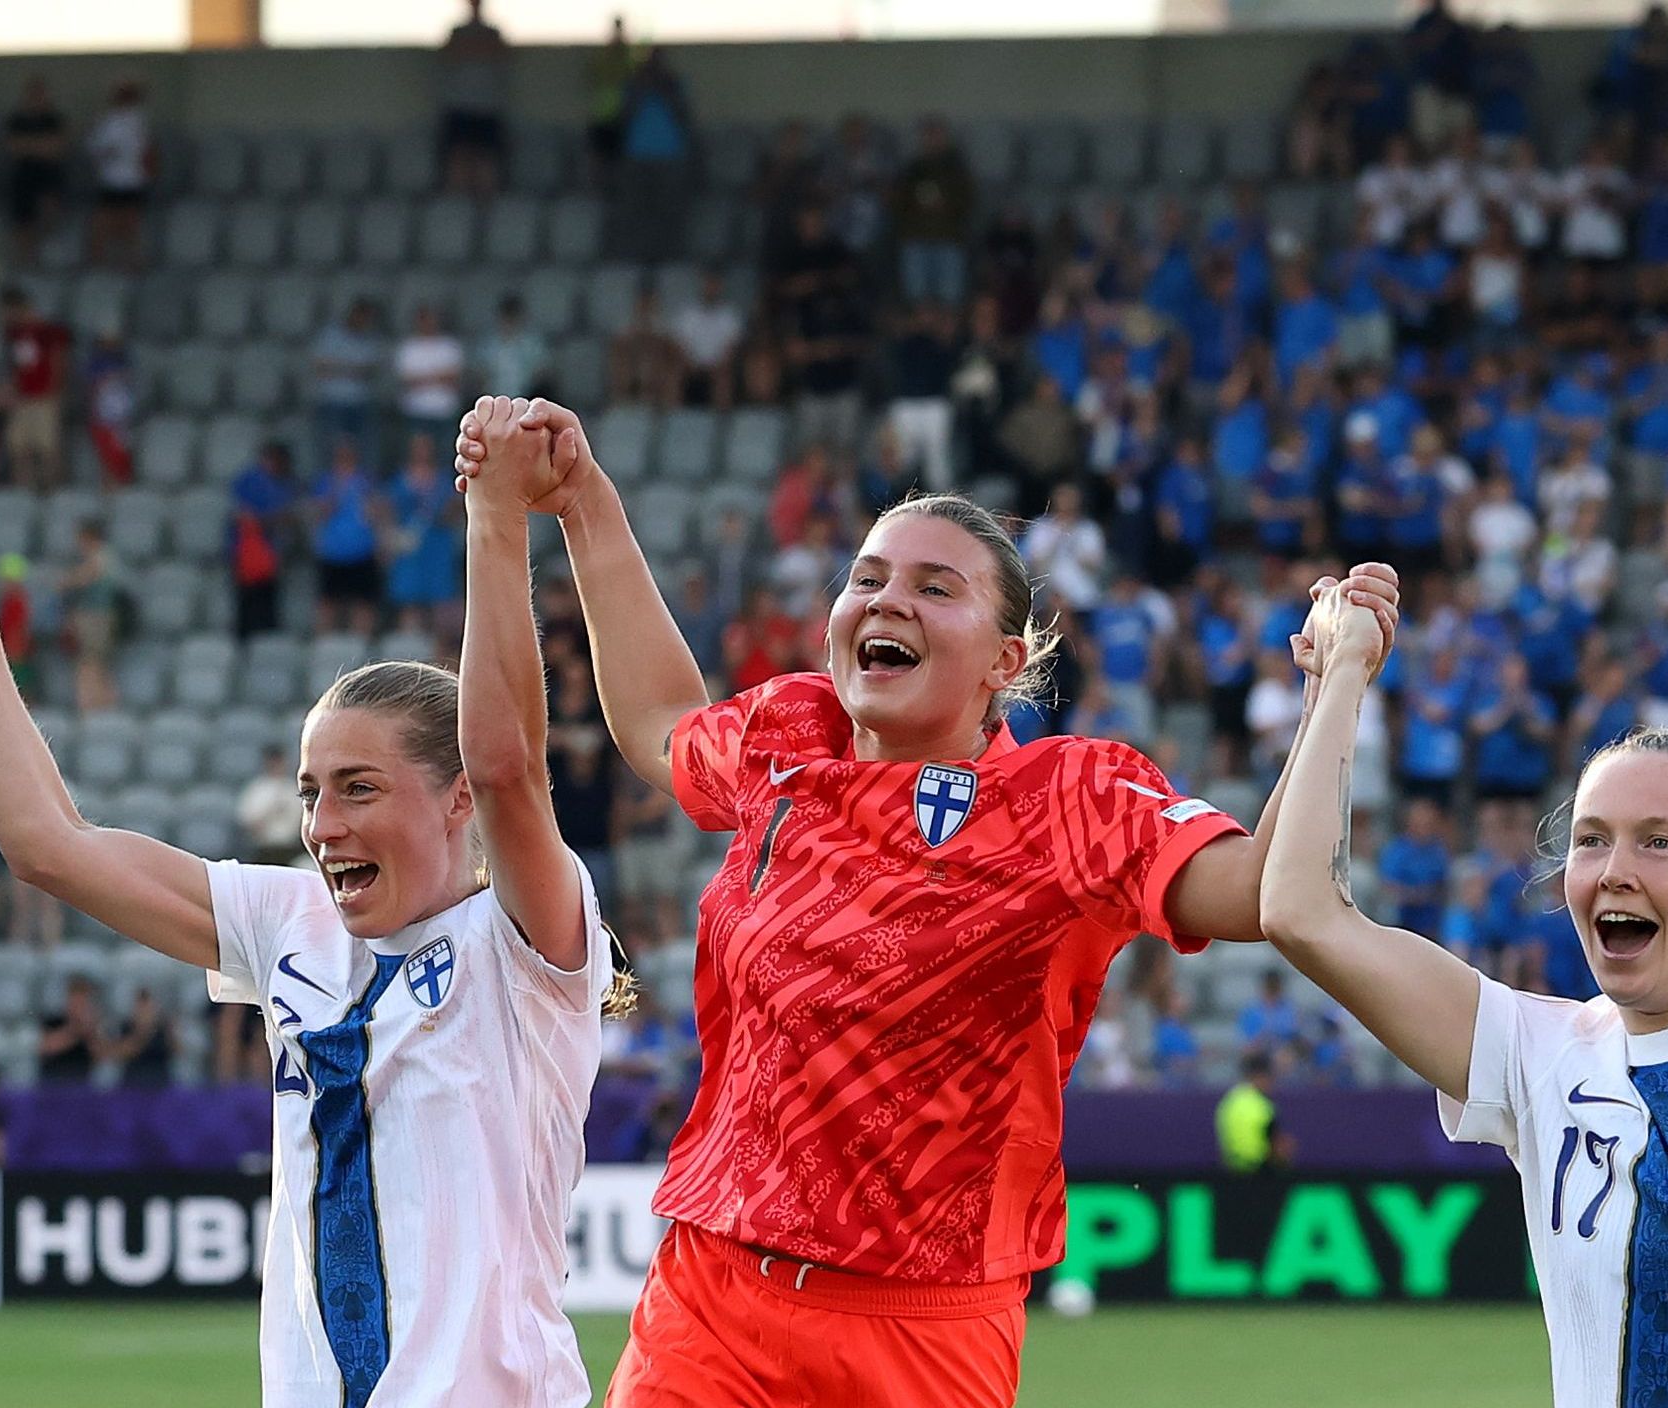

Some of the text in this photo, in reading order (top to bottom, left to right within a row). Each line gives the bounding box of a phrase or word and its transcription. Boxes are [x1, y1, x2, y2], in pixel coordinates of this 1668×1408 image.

[928, 770, 968, 784] SUOMI
[411, 944, 444, 967] SUOMI
[1550, 1126, 1621, 1241] 17
[1064, 1184, 1484, 1296] PLAY
